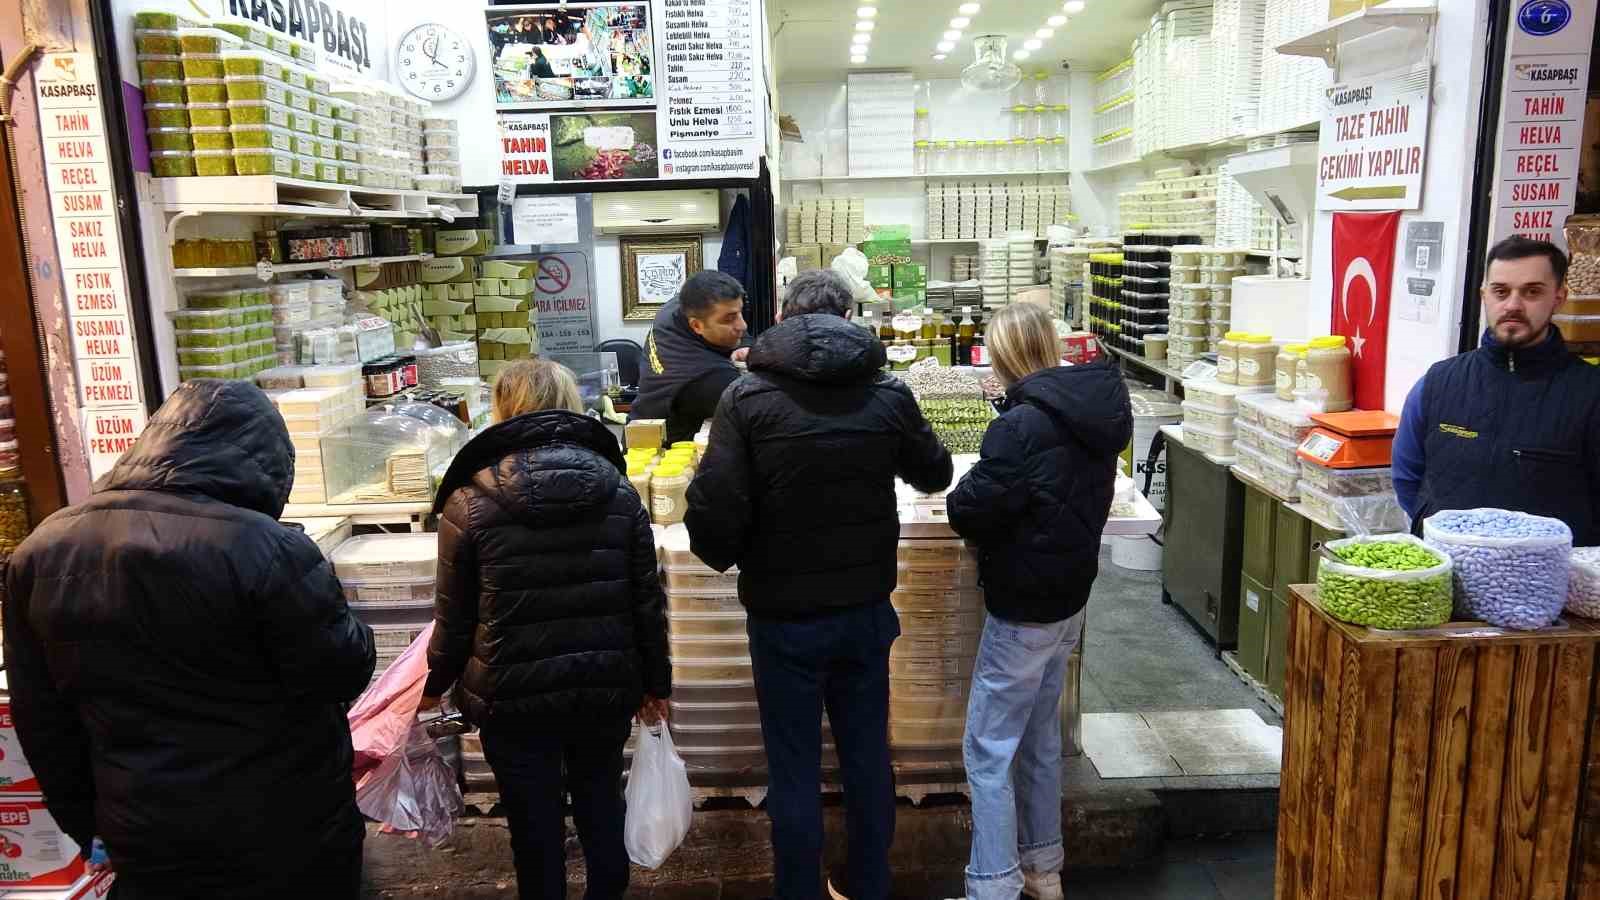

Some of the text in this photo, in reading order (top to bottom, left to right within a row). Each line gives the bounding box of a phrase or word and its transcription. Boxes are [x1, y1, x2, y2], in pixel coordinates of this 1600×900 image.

[687, 9, 704, 17] Helva
[691, 20, 708, 28] Helva
[693, 31, 710, 39] Helva
[667, 42, 687, 51] Cevizli
[688, 42, 704, 50] Sakız
[706, 41, 723, 50] Helva
[688, 52, 704, 61] Sakız
[706, 52, 723, 60] Helva
[668, 64, 683, 72] Tahin
[1531, 68, 1578, 84] KASAPBAŞI
[668, 75, 688, 83] Susam
[40, 84, 96, 101] KASAPBAŞI
[1334, 86, 1372, 106] KASAPBAŞI
[669, 97, 693, 105] Pekmez
[1524, 92, 1565, 116] TAHİN
[669, 107, 691, 115] Fıstık
[55, 110, 90, 131] TAHİN
[508, 123, 549, 132] KASAPBAŞI
[670, 118, 689, 126] Unlu
[693, 117, 719, 126] Helva
[1336, 99, 1410, 142] TAZE TAHİN
[1520, 126, 1561, 144] HELVA
[58, 142, 94, 158] HELVA
[502, 159, 549, 175] HELVA
[1320, 145, 1421, 188] ÇEKİMİ YAPILIR
[1517, 153, 1560, 177] REÇEL
[61, 169, 97, 189] REÇEL
[1512, 182, 1560, 201] SUSAM
[63, 194, 103, 211] SUSAM
[1514, 211, 1553, 229] SAKIZ
[70, 221, 104, 237] SAKIZ
[72, 242, 107, 257] HELVA
[75, 272, 112, 289] FISTIK
[77, 290, 117, 310] EZMESİ
[76, 320, 125, 336] SUSAMLI
[86, 340, 120, 355] HELVA
[90, 362, 122, 382] ÜZÜM
[85, 380, 133, 401] PEKMEZİ
[95, 416, 134, 435] ÜZÜM
[91, 437, 138, 454] PEKME
